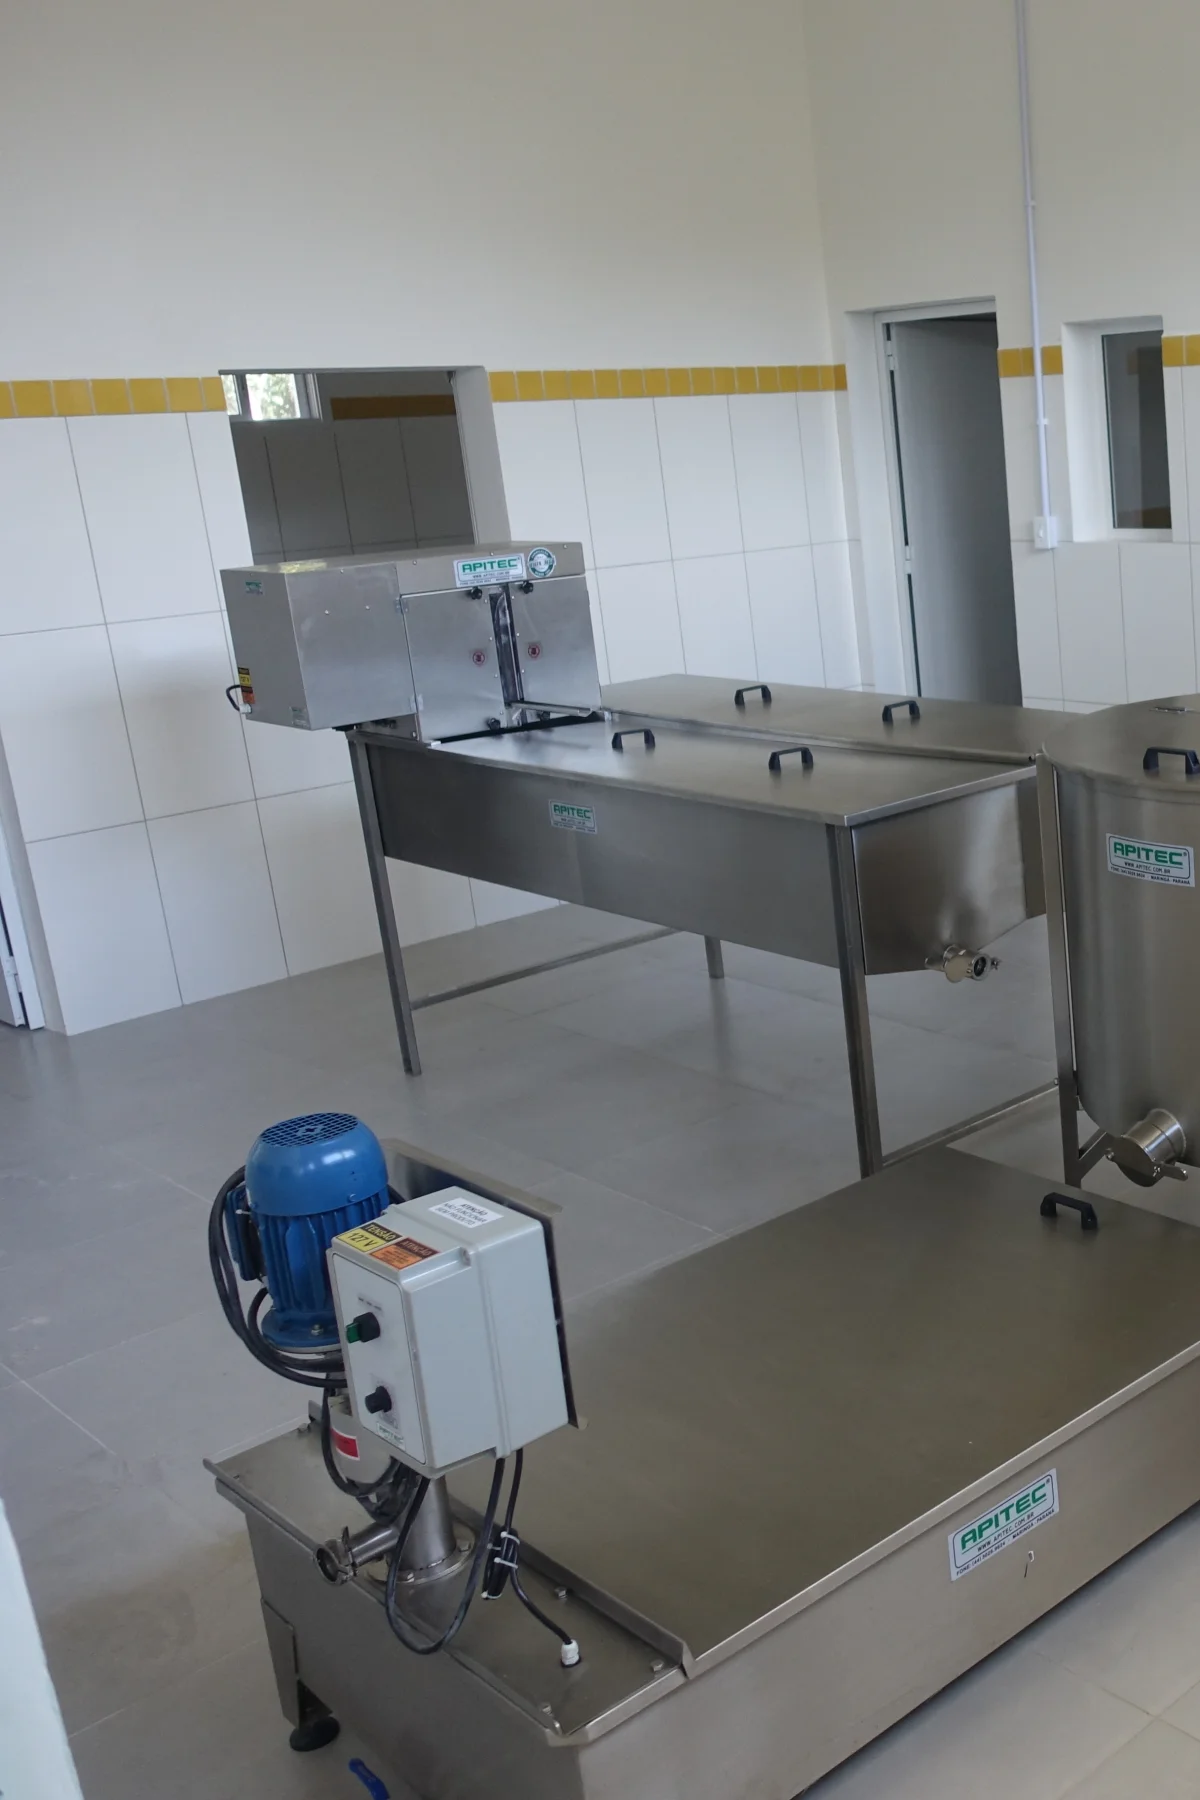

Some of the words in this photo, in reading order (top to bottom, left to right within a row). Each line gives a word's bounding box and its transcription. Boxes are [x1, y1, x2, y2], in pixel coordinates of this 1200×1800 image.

[462, 558, 518, 573] APITEC
[553, 804, 591, 819] APITEC
[1113, 841, 1183, 866] APITEC
[347, 1232, 369, 1244] 127
[364, 1224, 396, 1241] TENSÃO
[400, 1240, 433, 1256] ATENÇÃO
[960, 1483, 1046, 1550] APITEC
